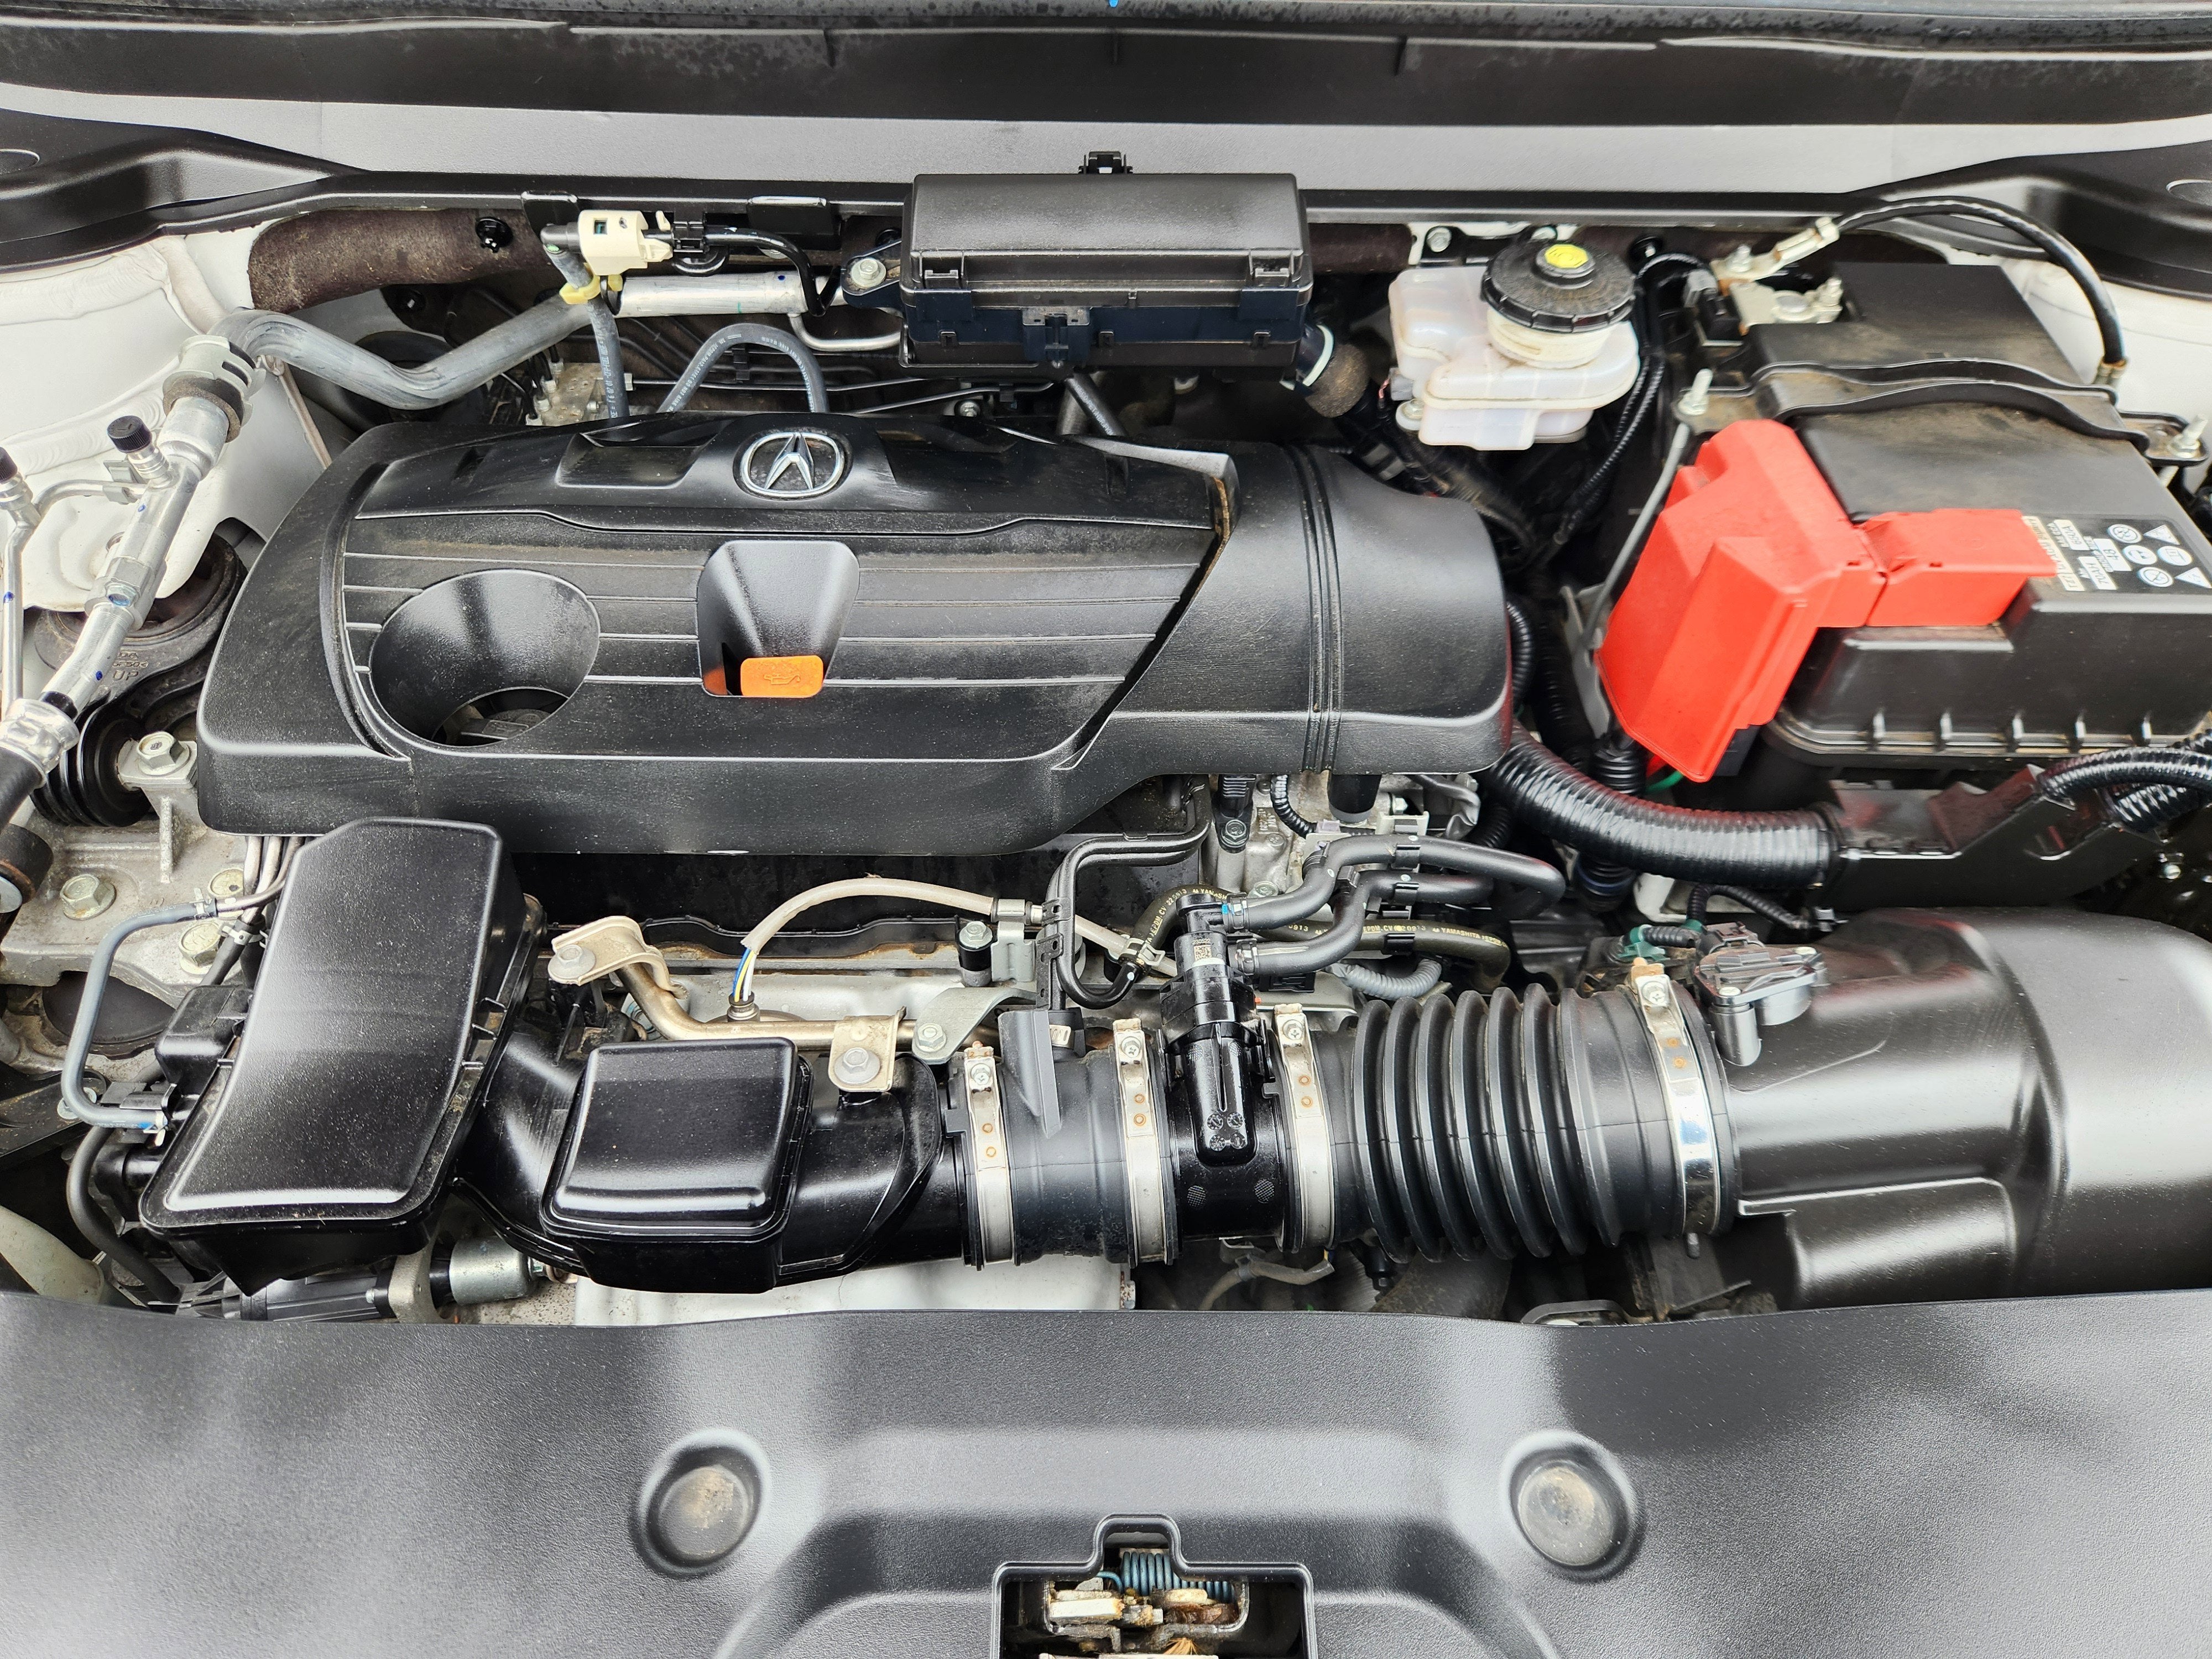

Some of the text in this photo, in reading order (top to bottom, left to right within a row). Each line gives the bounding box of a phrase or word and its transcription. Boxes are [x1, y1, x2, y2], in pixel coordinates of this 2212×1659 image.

[113, 670, 139, 681] UP
[1201, 889, 1228, 900] YAMASH
[1441, 927, 1481, 939] YAMASHITA
